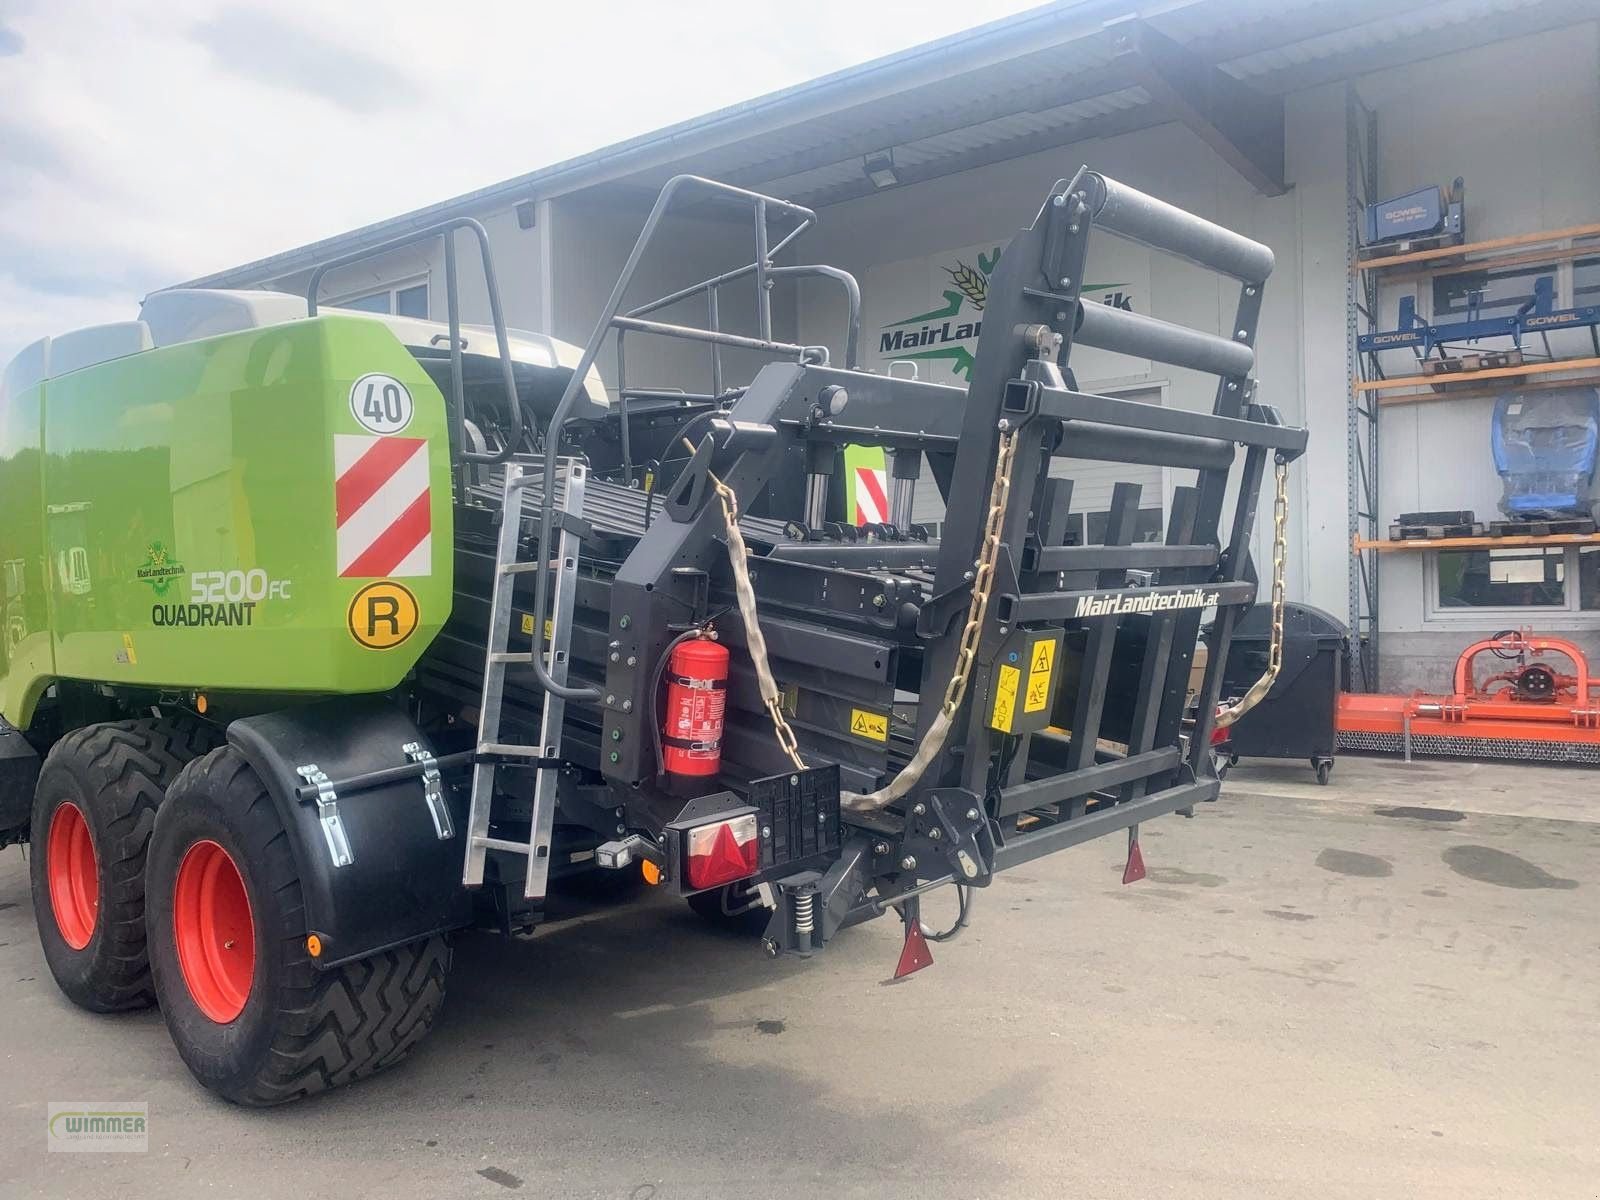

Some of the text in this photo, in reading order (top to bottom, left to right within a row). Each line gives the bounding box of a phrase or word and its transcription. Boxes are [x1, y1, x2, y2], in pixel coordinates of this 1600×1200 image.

[363, 383, 402, 424] 40
[152, 602, 256, 627] QUADRANT
[367, 596, 400, 637] R
[1075, 589, 1219, 617] MairLandtechnik.at
